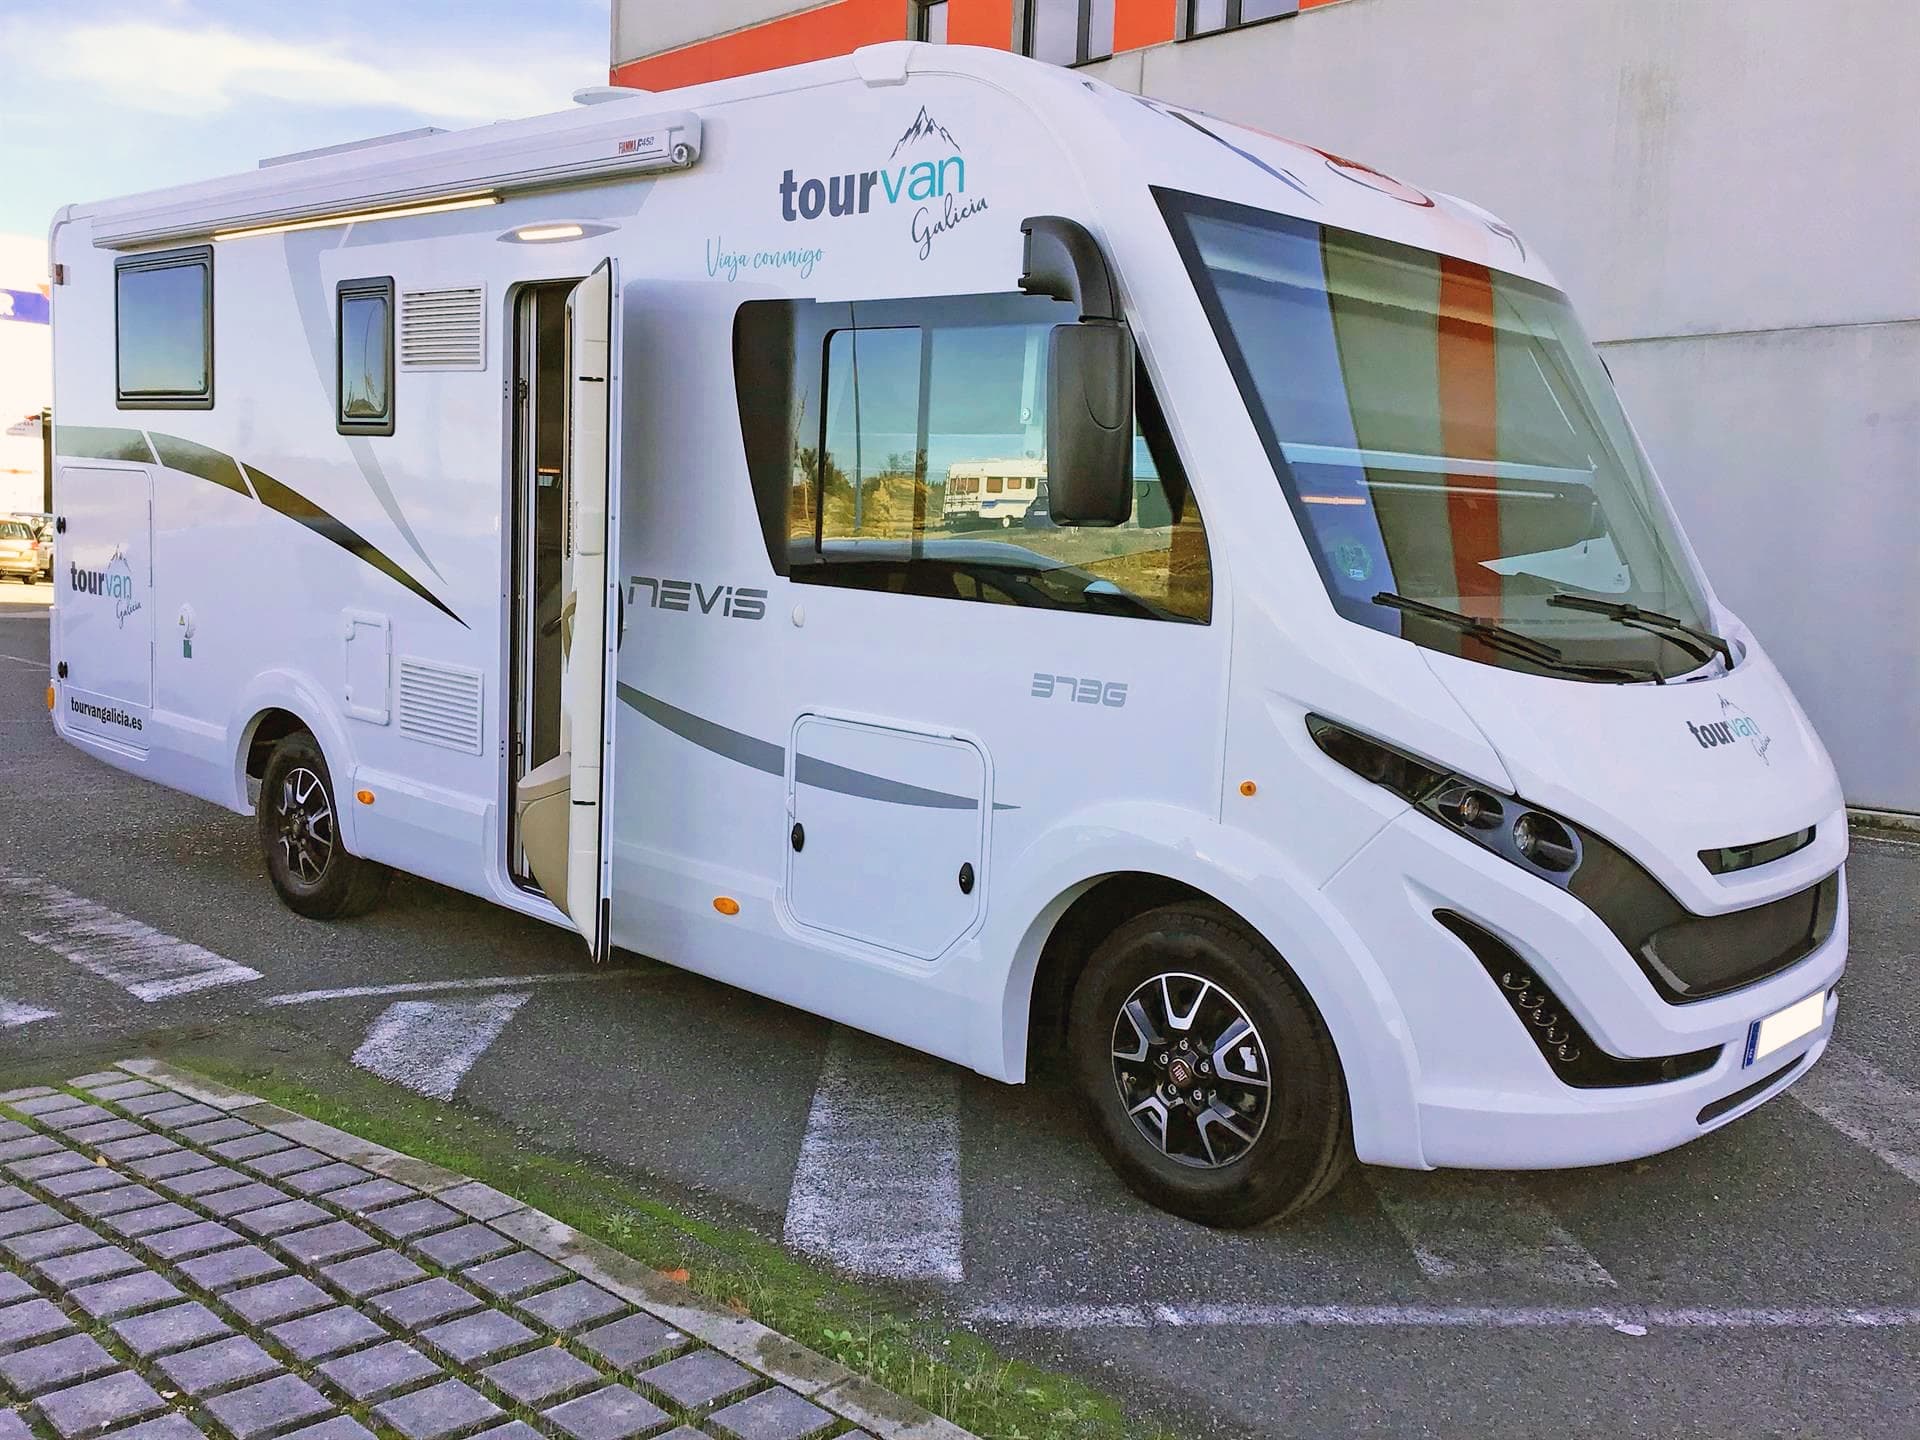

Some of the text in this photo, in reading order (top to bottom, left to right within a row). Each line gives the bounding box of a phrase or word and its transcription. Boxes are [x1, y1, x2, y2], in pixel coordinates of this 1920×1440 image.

[779, 155, 965, 222] tourvan
[911, 192, 989, 261] Galicia
[706, 235, 825, 283] Viaja conmigo
[70, 560, 132, 599] tourvan
[1031, 672, 1129, 708] 373G
[70, 696, 143, 731] tourvangalicia.es
[1686, 716, 1762, 749] tourvan
[1172, 1064, 1188, 1082] FIAT
